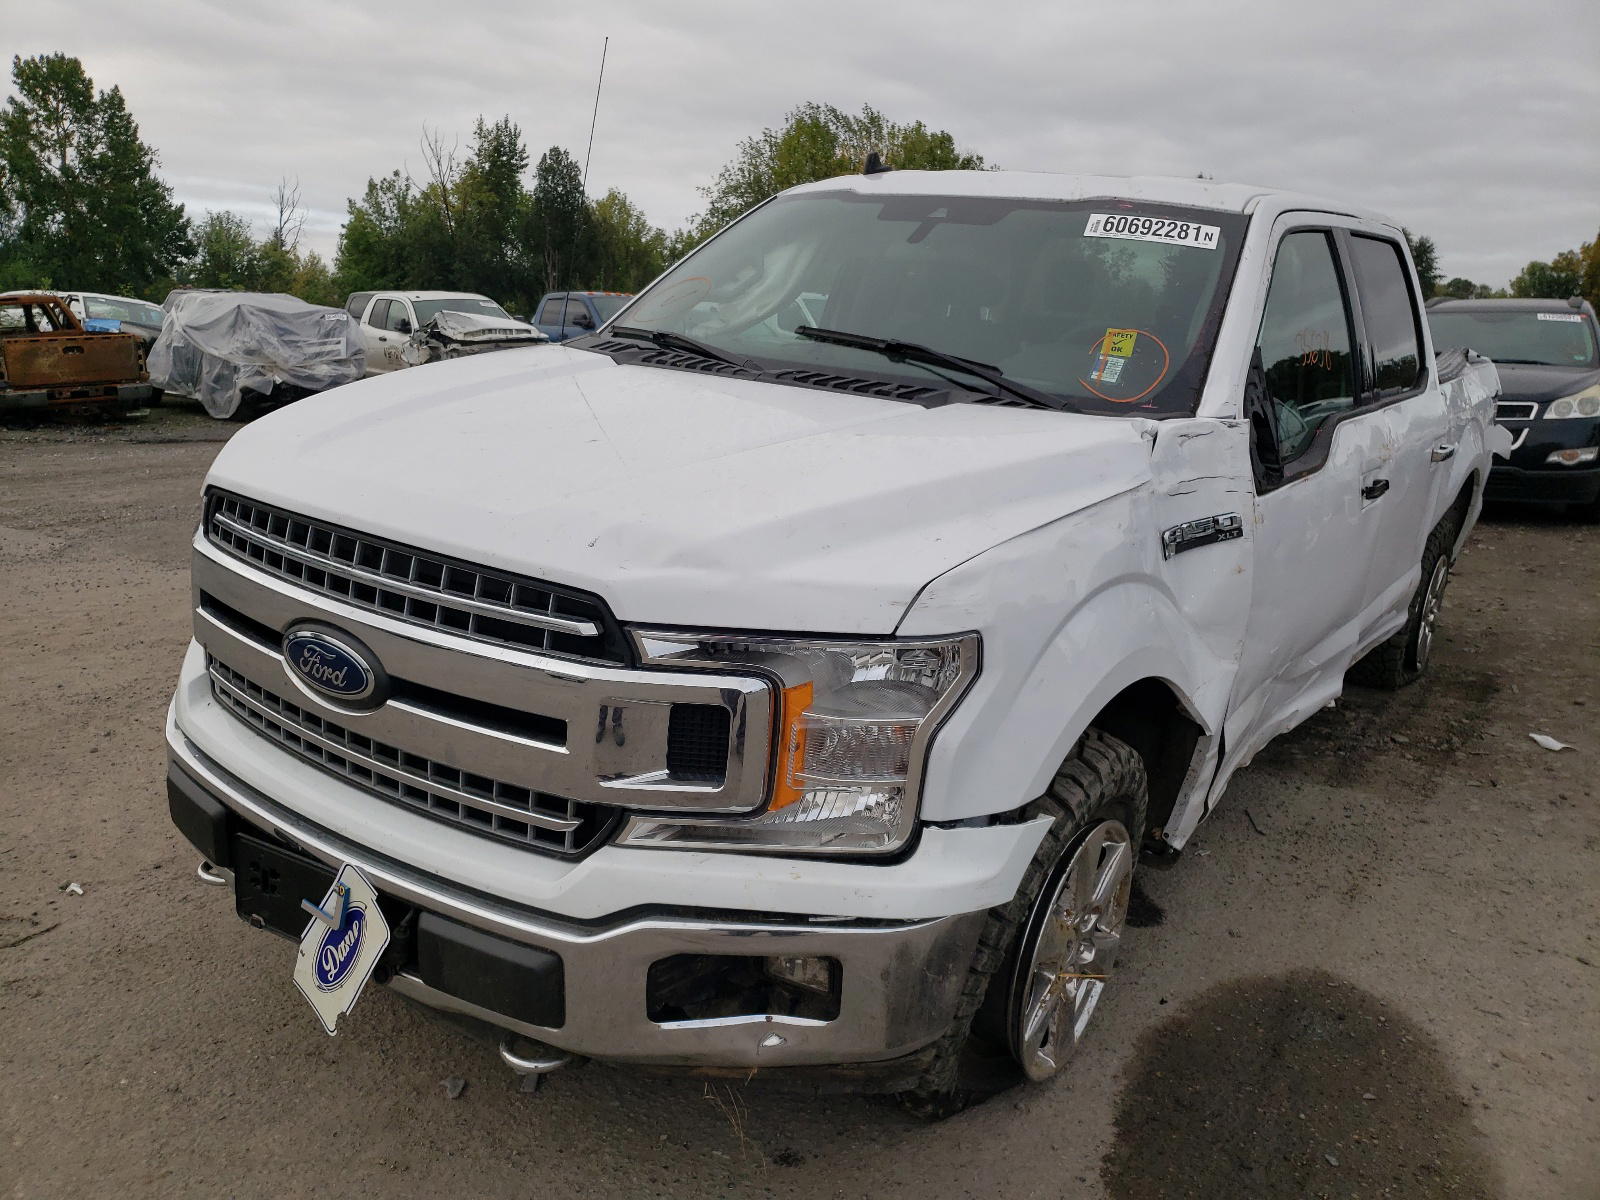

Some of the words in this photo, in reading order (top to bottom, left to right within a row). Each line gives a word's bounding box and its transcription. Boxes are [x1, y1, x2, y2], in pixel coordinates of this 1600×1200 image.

[1102, 215, 1202, 242] 60692281
[1203, 232, 1214, 242] N
[1217, 530, 1240, 542] XLT
[299, 643, 348, 688] Ford
